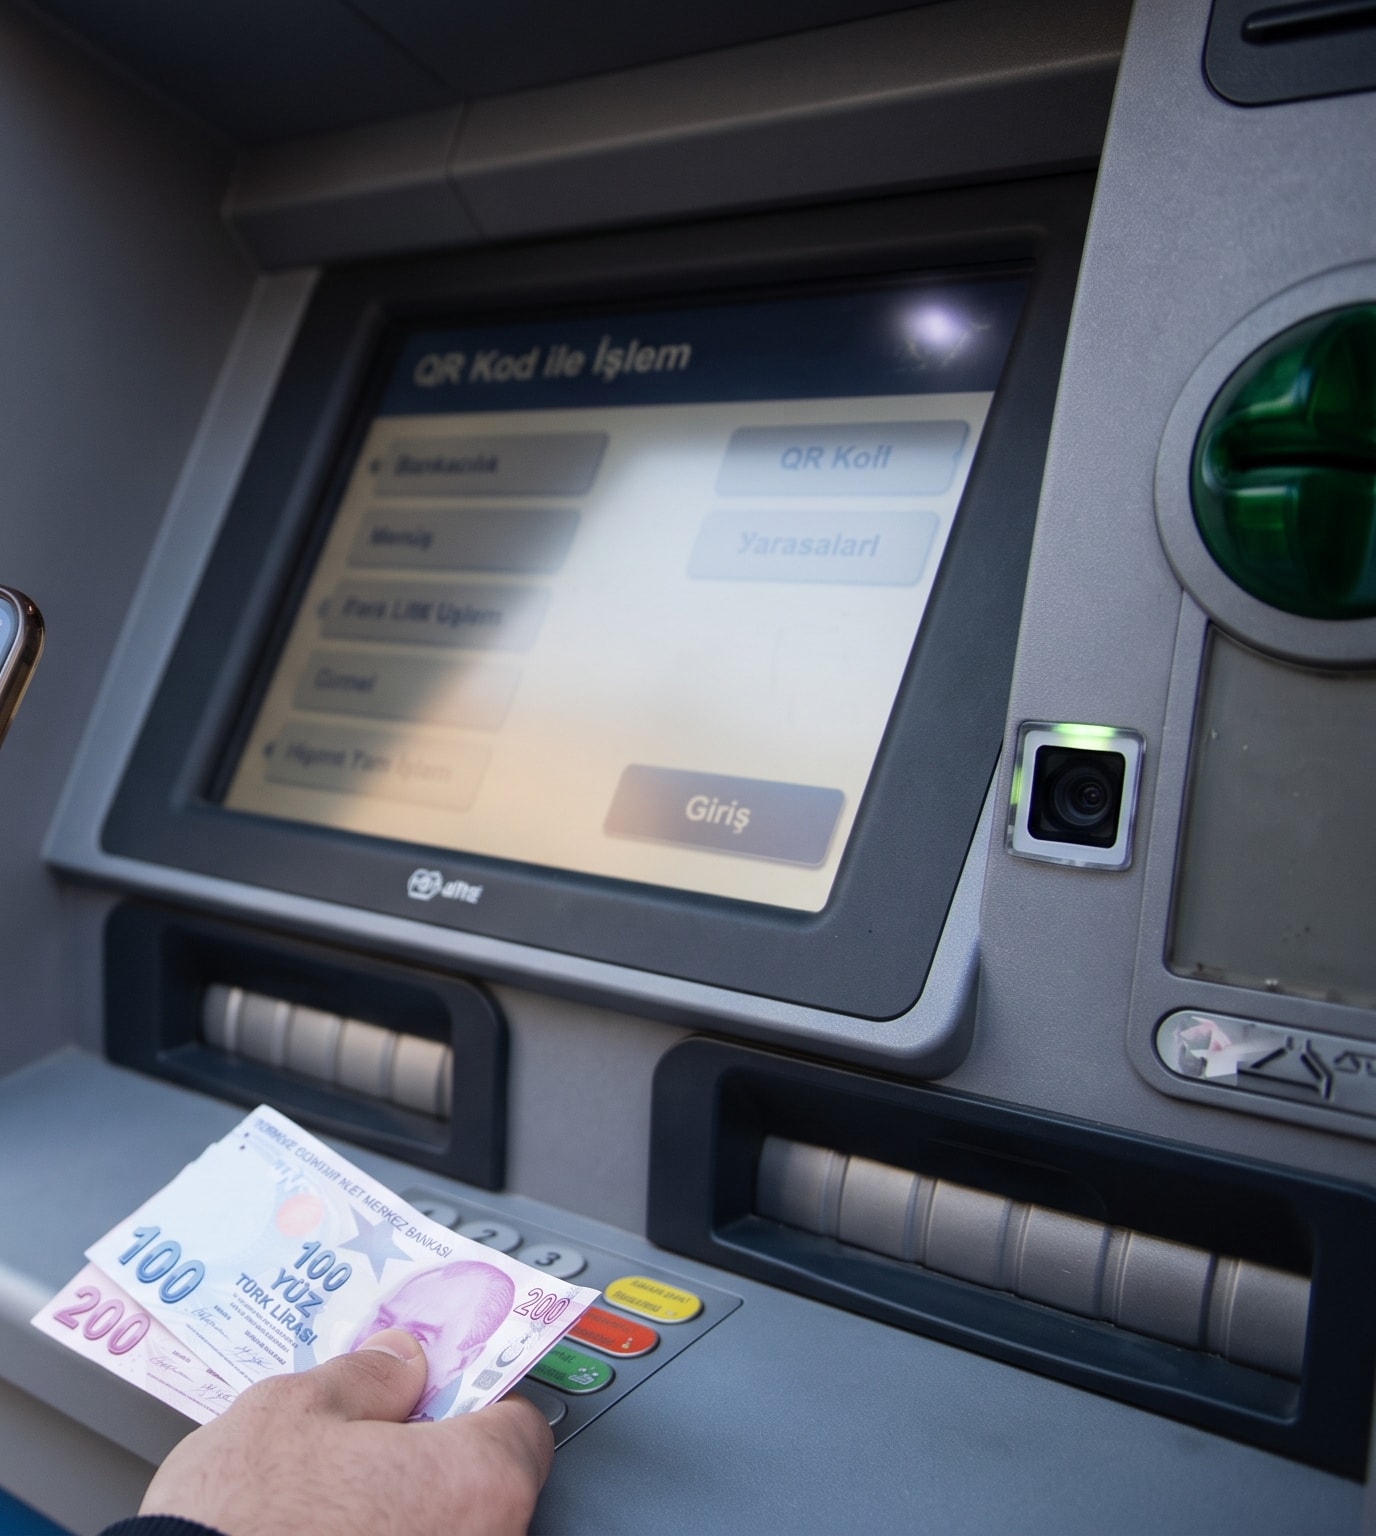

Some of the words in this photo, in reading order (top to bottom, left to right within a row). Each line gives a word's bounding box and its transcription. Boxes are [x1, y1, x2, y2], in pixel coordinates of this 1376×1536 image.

[414, 353, 466, 387] QR
[470, 346, 541, 383] Kod
[543, 345, 585, 379] ile
[592, 334, 692, 382] İşlem
[780, 446, 824, 470] QR
[686, 796, 751, 834] Giriş
[405, 1227, 453, 1258] BANKASI
[534, 1251, 561, 1266] 3
[118, 1226, 205, 1304] 100
[294, 1241, 352, 1292] 100
[271, 1267, 324, 1318] YÜZ
[513, 1288, 571, 1325] 200
[53, 1286, 151, 1355] 200
